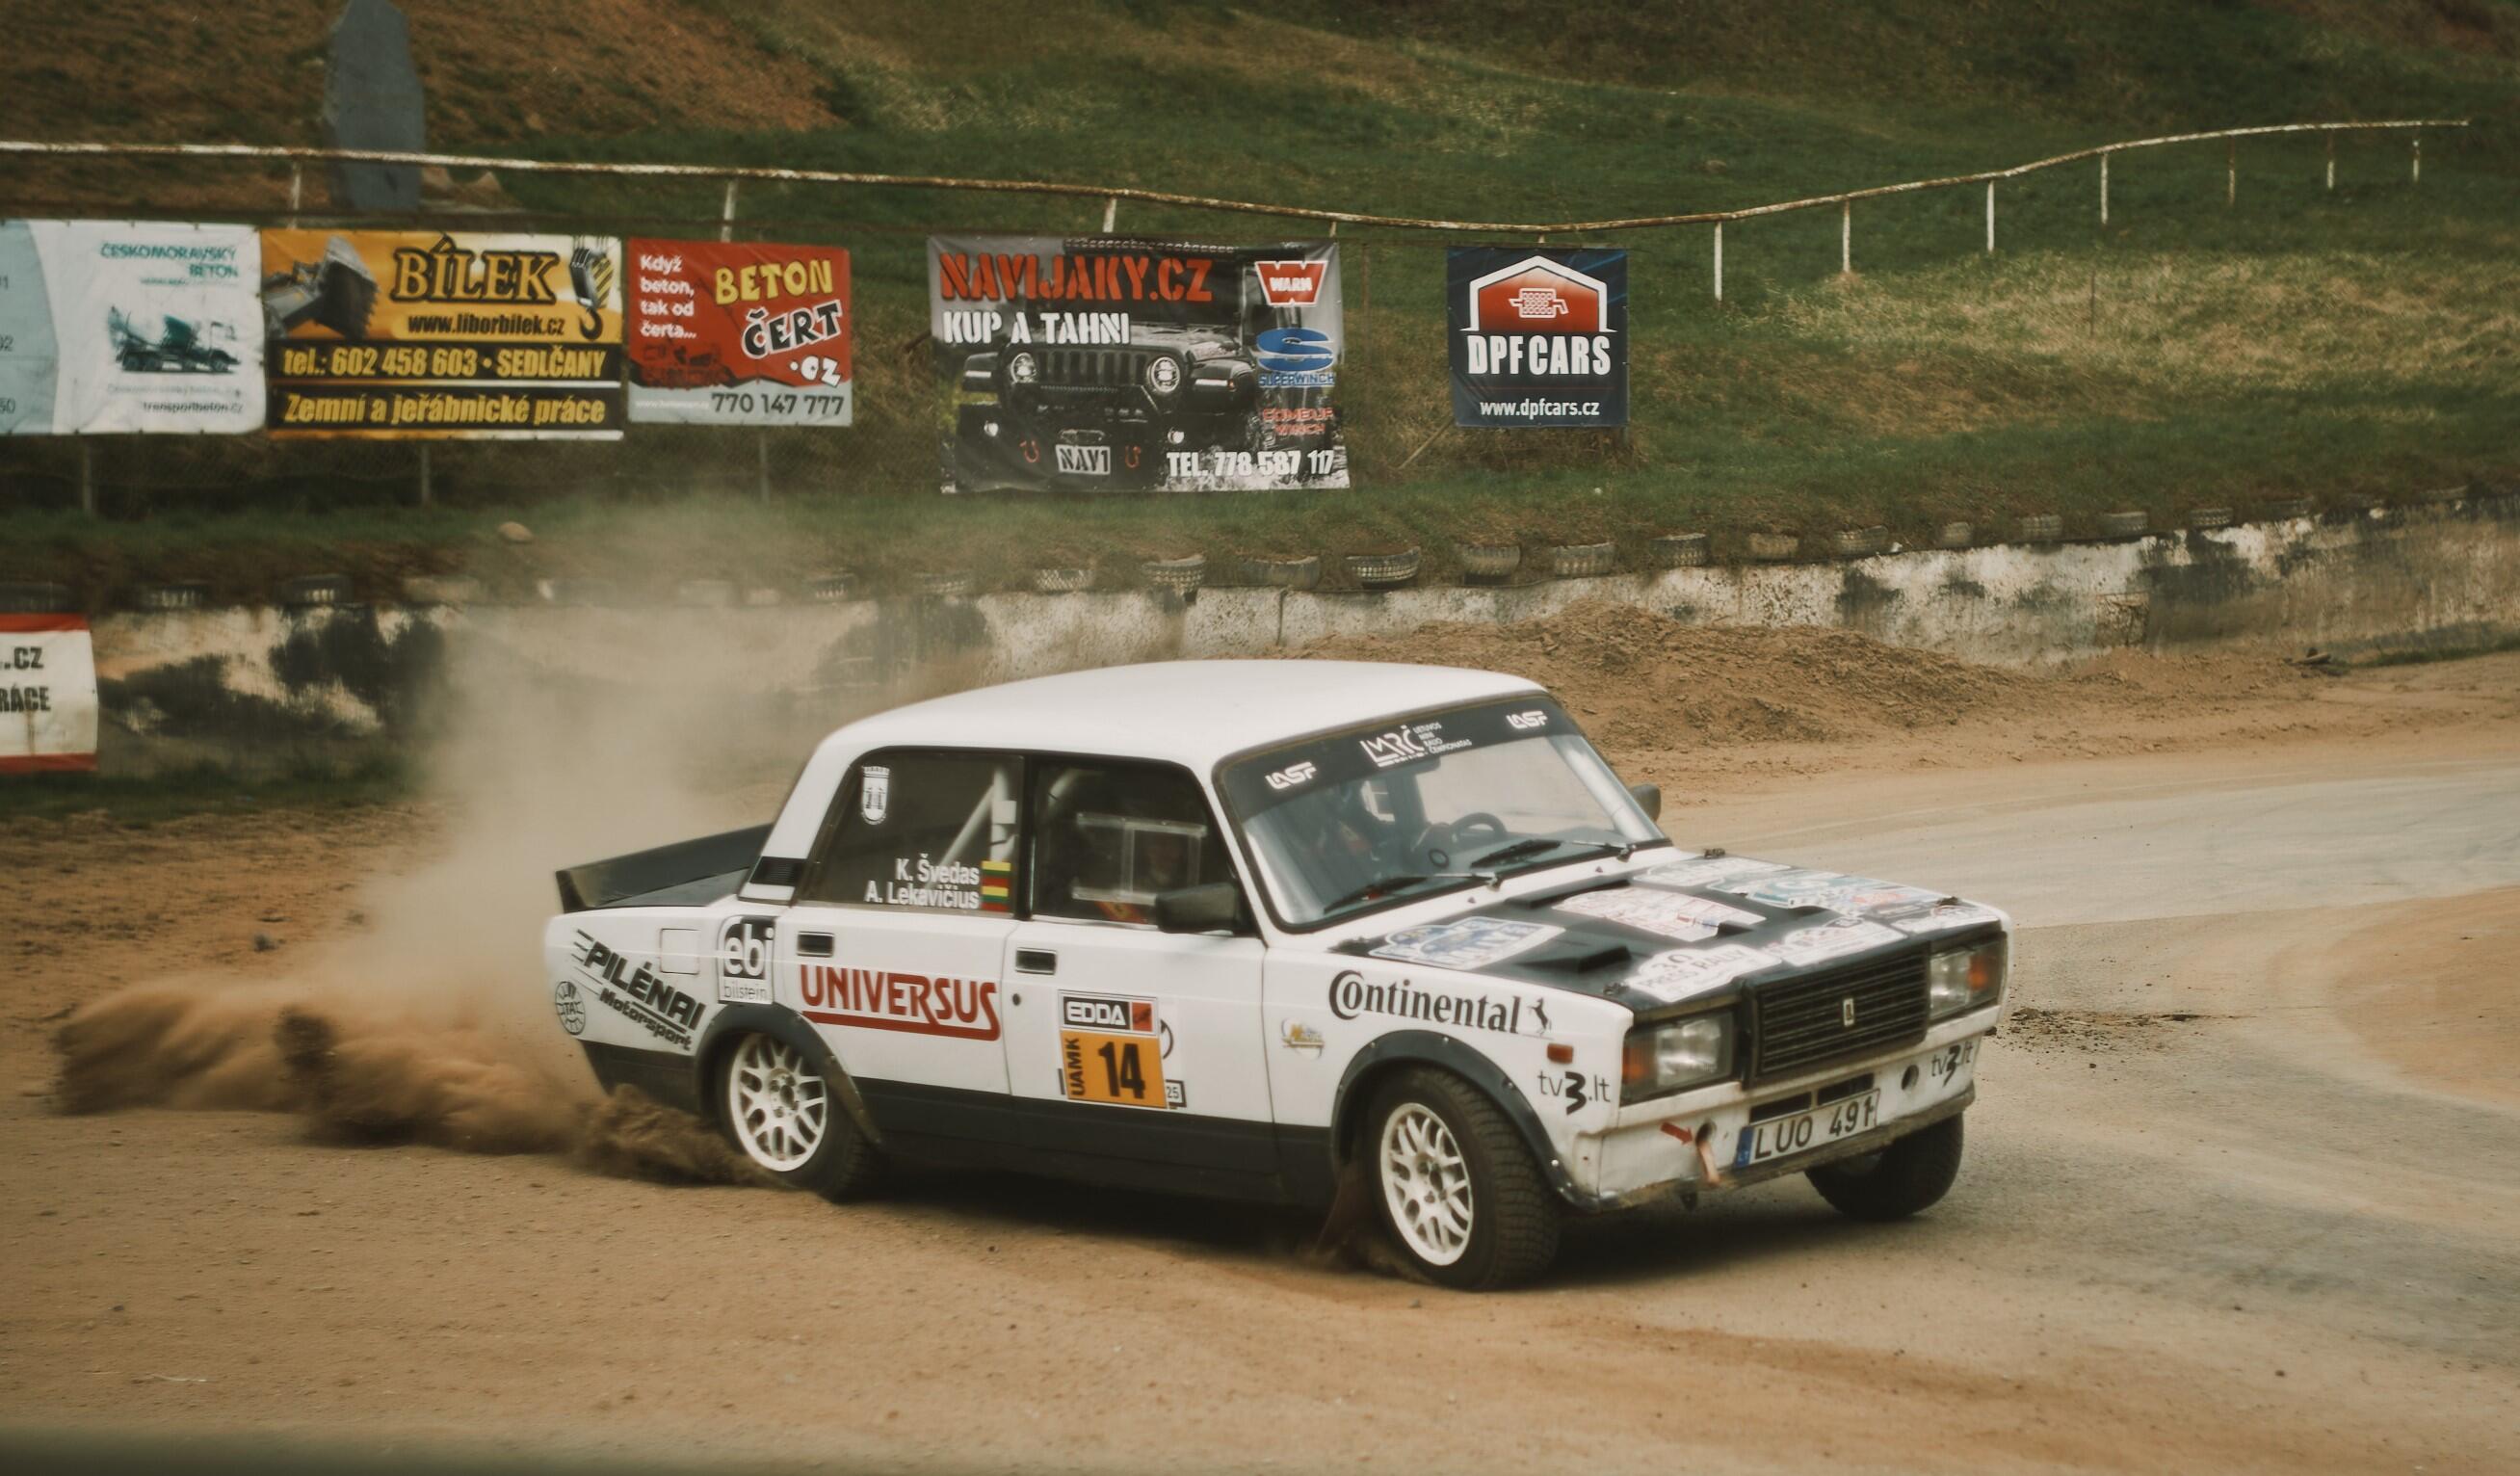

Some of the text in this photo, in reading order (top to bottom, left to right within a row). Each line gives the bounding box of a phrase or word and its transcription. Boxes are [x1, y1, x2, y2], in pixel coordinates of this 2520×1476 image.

[189, 263, 239, 277] BETON
[391, 234, 559, 304] BÍLEK
[640, 254, 683, 275] Když
[939, 251, 1214, 303] NAVIJAKY.CZ
[640, 277, 695, 300] beton,
[716, 259, 833, 305] BETON
[407, 313, 565, 335] www.liborbilek.cz
[640, 301, 695, 317] tak od
[741, 299, 843, 360] ČERT
[942, 310, 1003, 344] KUP
[1011, 311, 1033, 344] A
[283, 345, 608, 379] tel.: 602 458 603 SEDLČANY
[285, 394, 606, 426] Zemní a jeřábnické práce
[711, 392, 754, 413] 770
[760, 393, 798, 414] 147
[803, 395, 845, 416] 777
[1480, 398, 1601, 421] www.dpfcars.cz
[1167, 450, 1335, 478] TEL. 778 587 117
[895, 853, 980, 885] K. Švedas
[864, 880, 980, 909] A. Lekavičius
[801, 963, 1001, 1041] UNIVERSUS
[1065, 1000, 1127, 1027] EDDA
[1328, 969, 1522, 1035] Continental
[598, 987, 694, 1052] Motorsport
[1097, 1041, 1146, 1100] 14
[1536, 1067, 1612, 1117] tv3.lt
[1754, 1095, 1874, 1160] LUO 491
